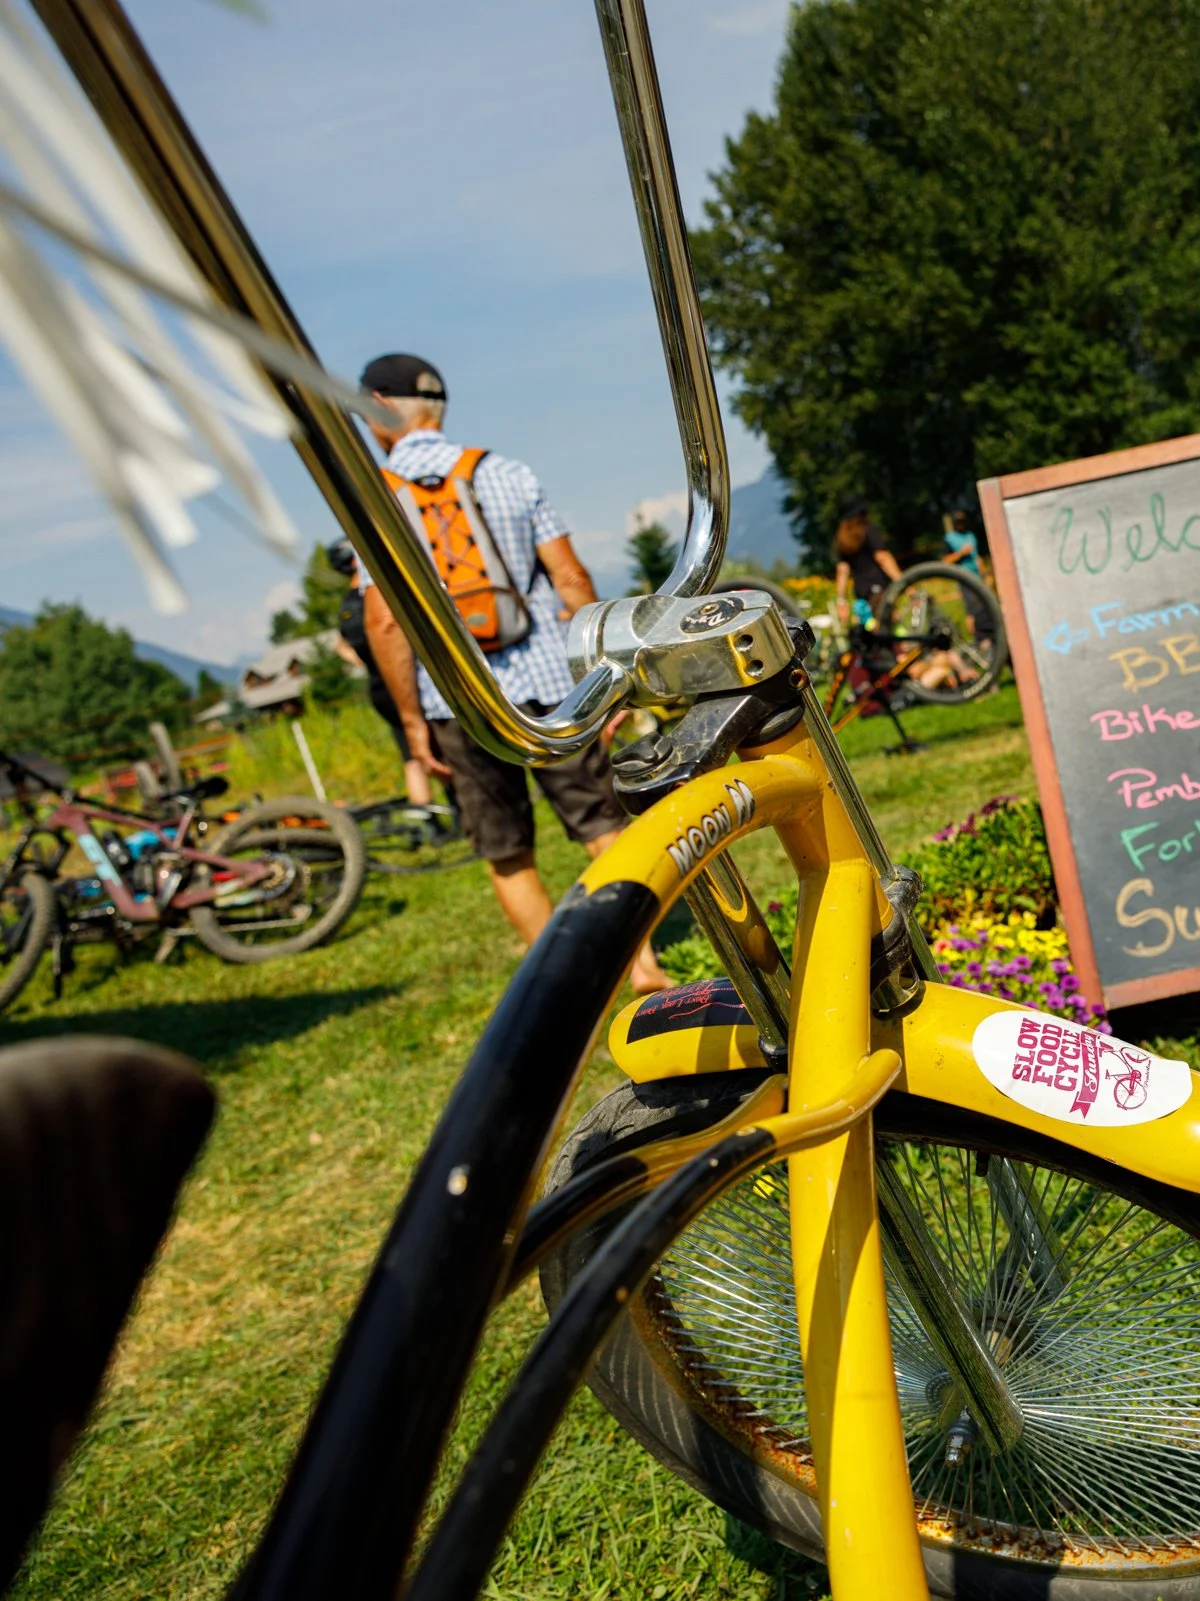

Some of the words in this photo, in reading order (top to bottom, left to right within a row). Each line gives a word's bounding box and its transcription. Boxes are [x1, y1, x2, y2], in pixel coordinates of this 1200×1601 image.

[1090, 601, 1200, 639] Farm
[666, 802, 731, 876] MOON
[1012, 1017, 1041, 1082] SLOW
[1032, 1023, 1062, 1087] FOOD
[1054, 1029, 1080, 1092] CYCLE
[1084, 1033, 1097, 1092] Sunday
